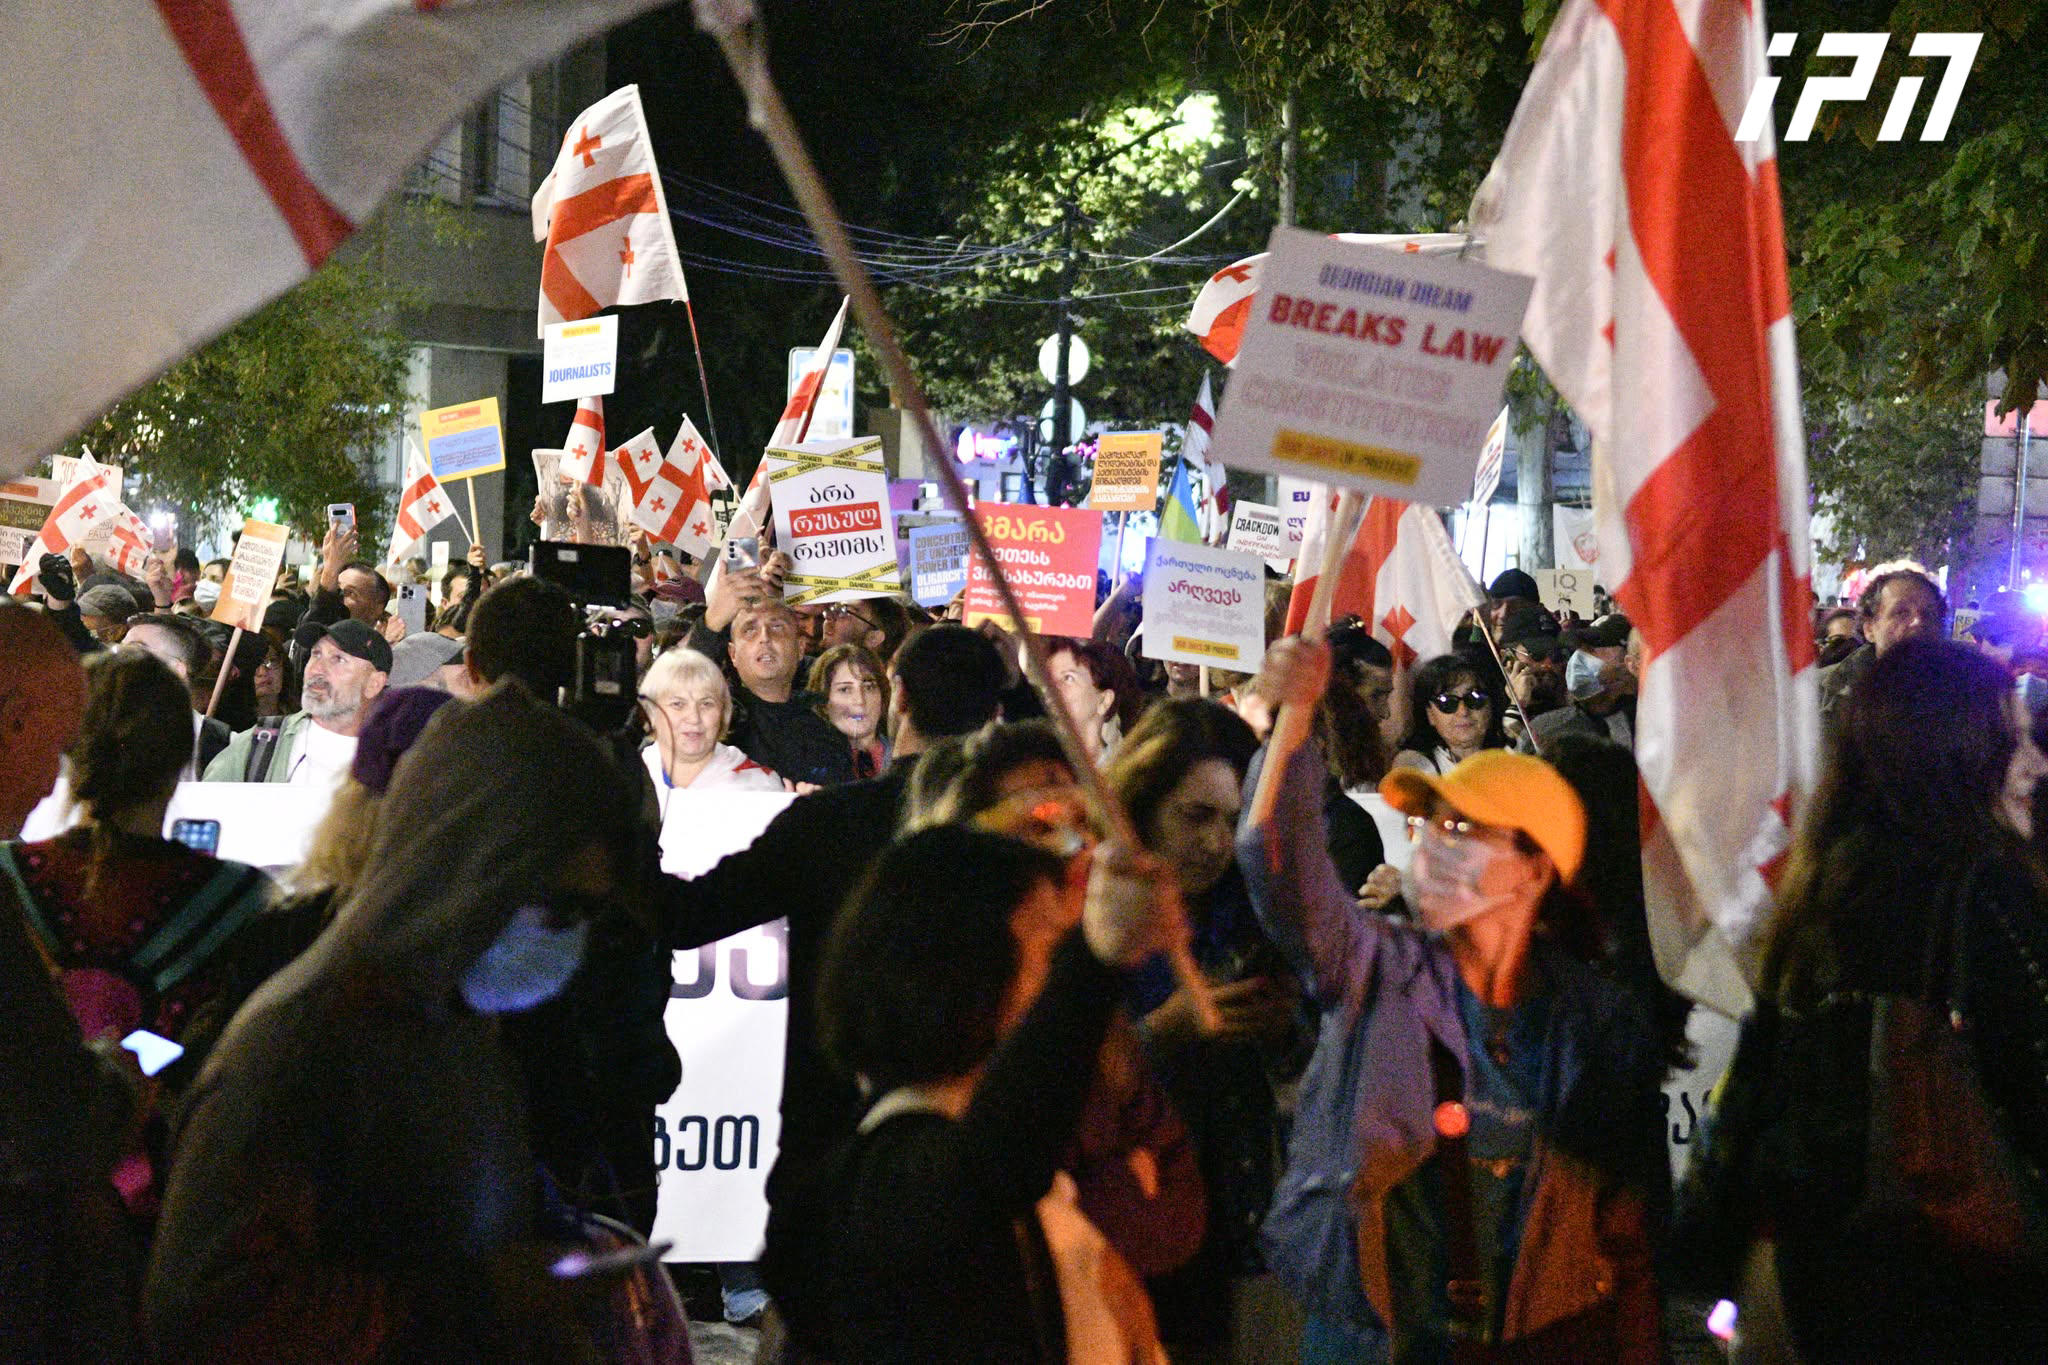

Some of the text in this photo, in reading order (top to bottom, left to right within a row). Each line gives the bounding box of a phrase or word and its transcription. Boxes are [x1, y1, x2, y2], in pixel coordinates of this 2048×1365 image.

[1319, 263, 1474, 314] GEORGIAN DREAM
[1268, 294, 1506, 366] BREAKS LAW
[549, 362, 611, 383] JOURNALISTS
[809, 484, 855, 504] არა
[1293, 491, 1310, 502] EU
[793, 507, 878, 533] რუსულ
[1235, 517, 1279, 536] CRACKDOW
[793, 535, 886, 561] რეჟიმს!
[917, 560, 948, 576] POWER
[951, 558, 960, 569] IN
[972, 565, 1092, 590] ვისახურებთ
[1156, 555, 1256, 581] ქართული ოცნება
[917, 583, 948, 600] HANDS
[1168, 580, 1241, 606] არღვევს
[1553, 573, 1577, 592] IQ
